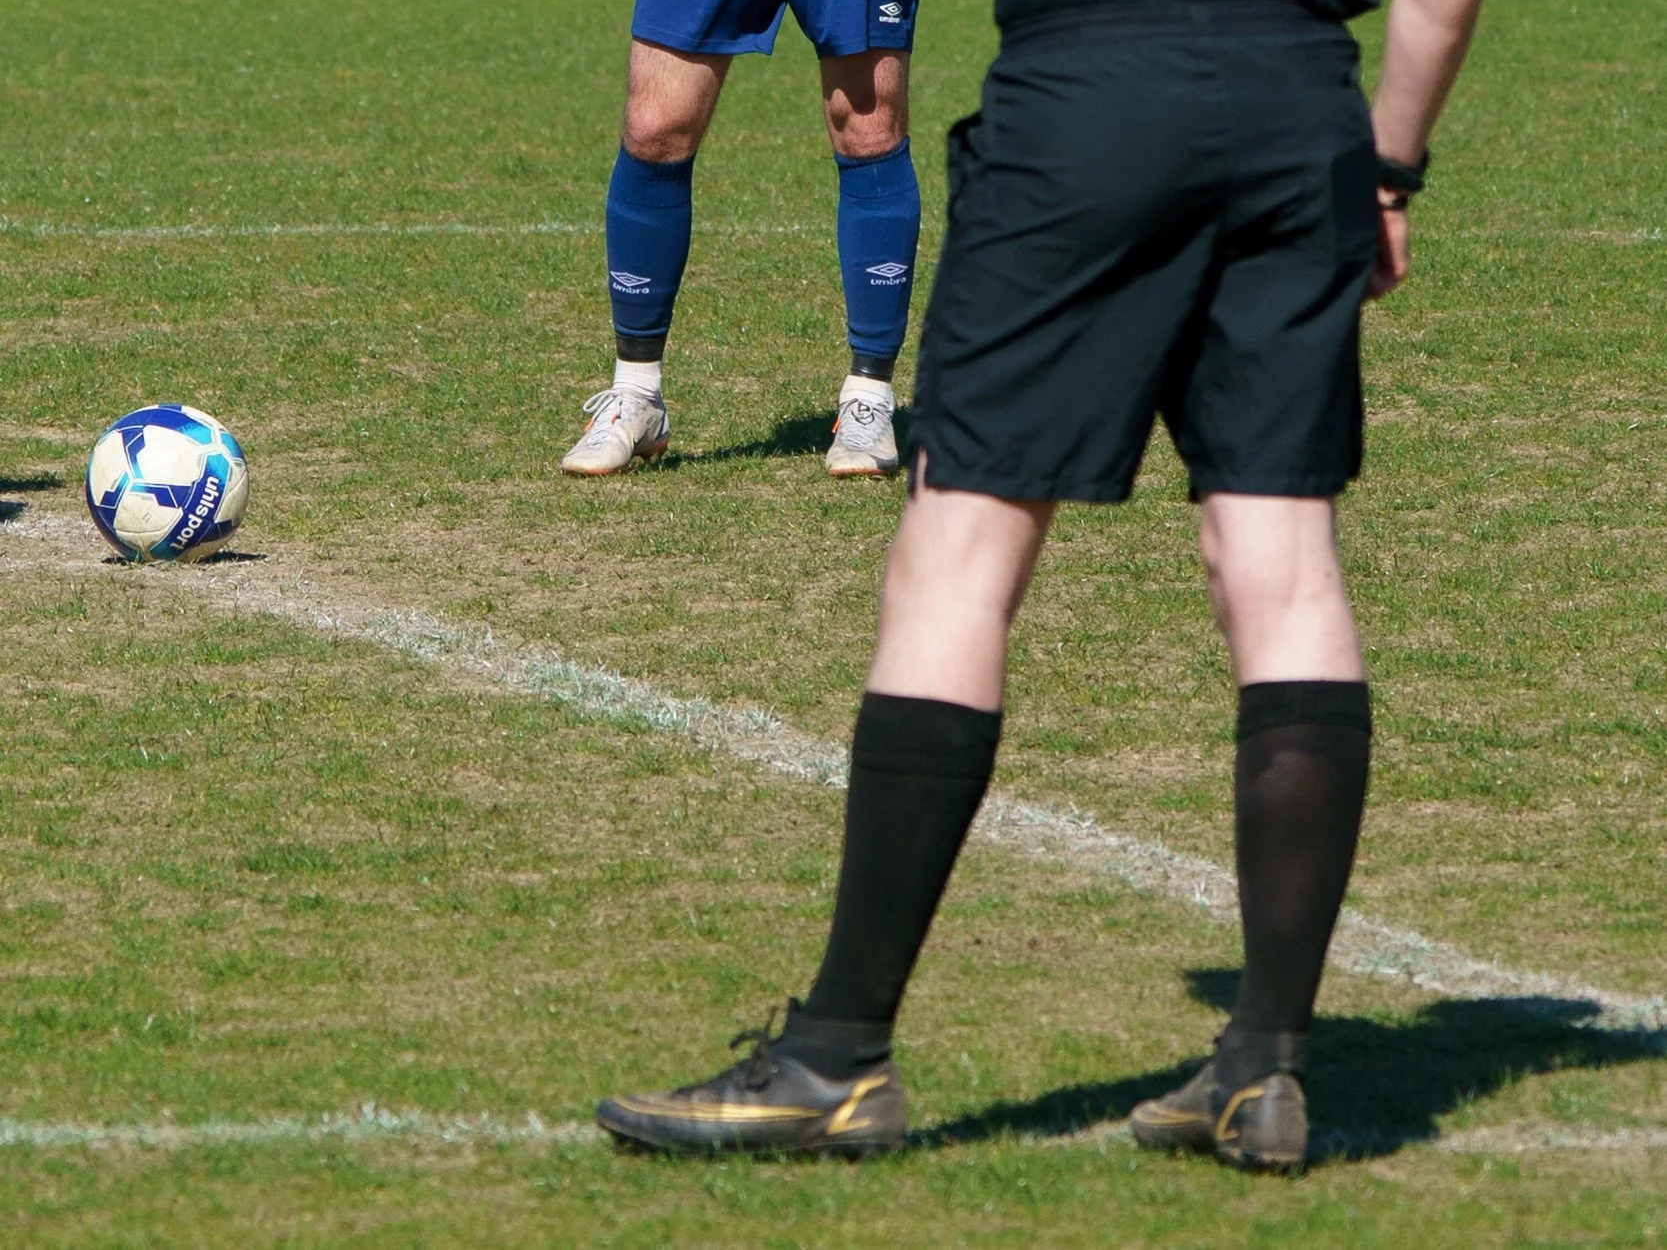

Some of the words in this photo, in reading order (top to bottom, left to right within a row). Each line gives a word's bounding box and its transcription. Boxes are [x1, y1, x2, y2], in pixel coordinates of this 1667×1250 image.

[870, 276, 907, 286] umbro
[612, 282, 650, 295] umbro
[170, 476, 219, 550] uhlsport
